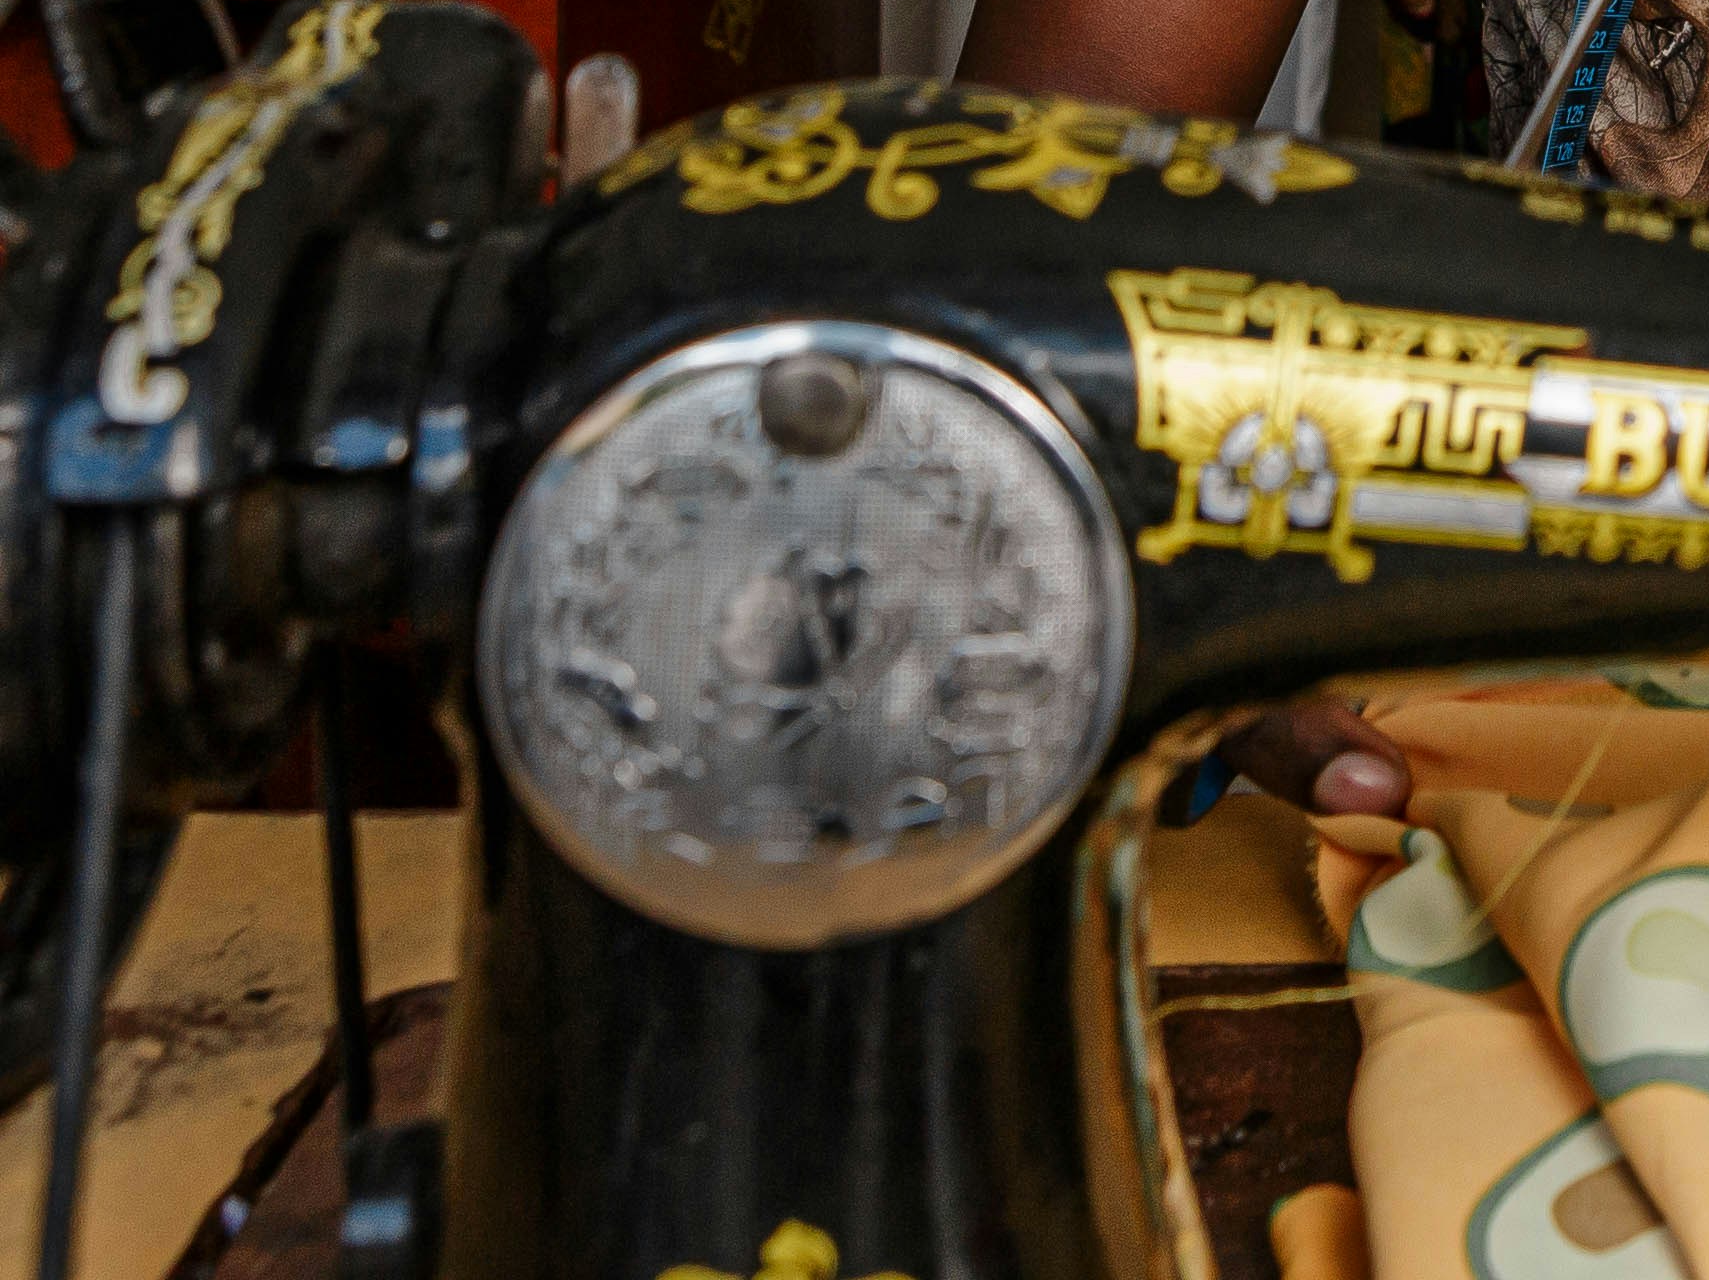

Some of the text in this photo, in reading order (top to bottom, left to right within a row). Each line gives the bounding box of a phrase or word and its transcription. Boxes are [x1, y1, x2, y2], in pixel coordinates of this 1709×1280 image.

[1588, 30, 1608, 50] 23
[1574, 67, 1596, 87] 124
[1565, 104, 1586, 125] 125
[1556, 142, 1575, 162] 126
